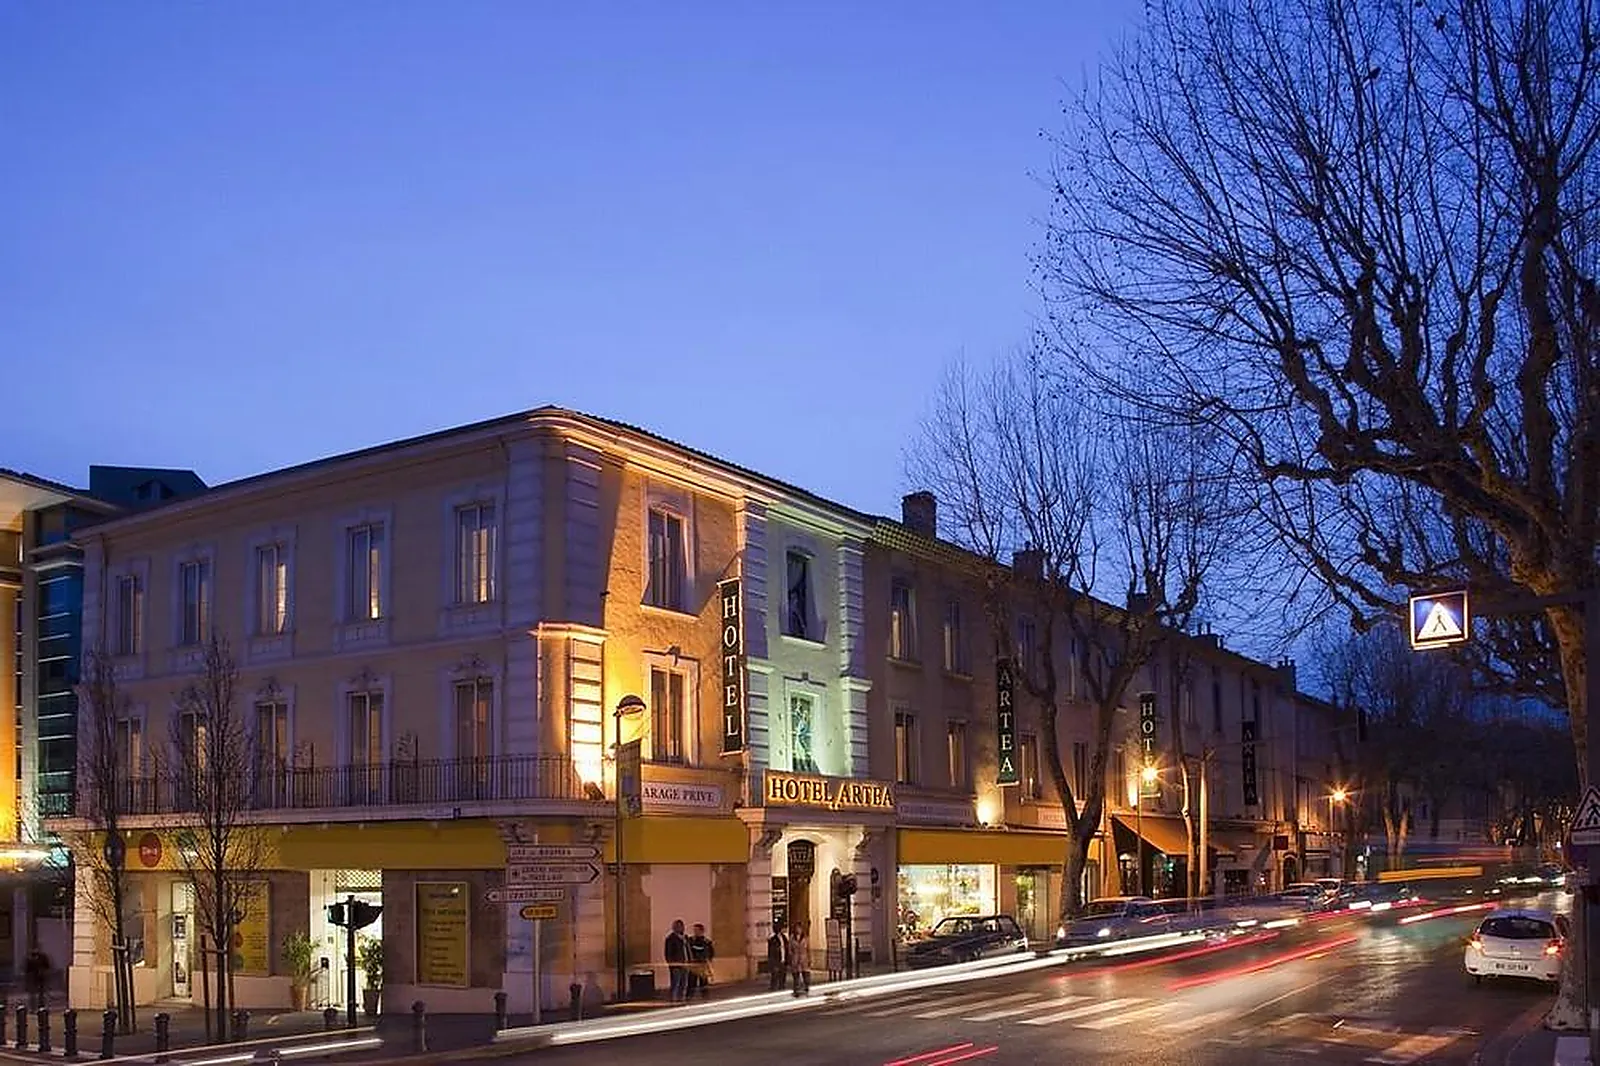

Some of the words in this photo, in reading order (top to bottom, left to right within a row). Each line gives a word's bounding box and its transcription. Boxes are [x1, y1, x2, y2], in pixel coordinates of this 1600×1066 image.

[722, 595, 739, 736] HOTEL
[999, 669, 1015, 773] ARTEA
[642, 787, 680, 801] ARAGE
[769, 777, 835, 803] HOTEL
[836, 781, 894, 807] ARTEA
